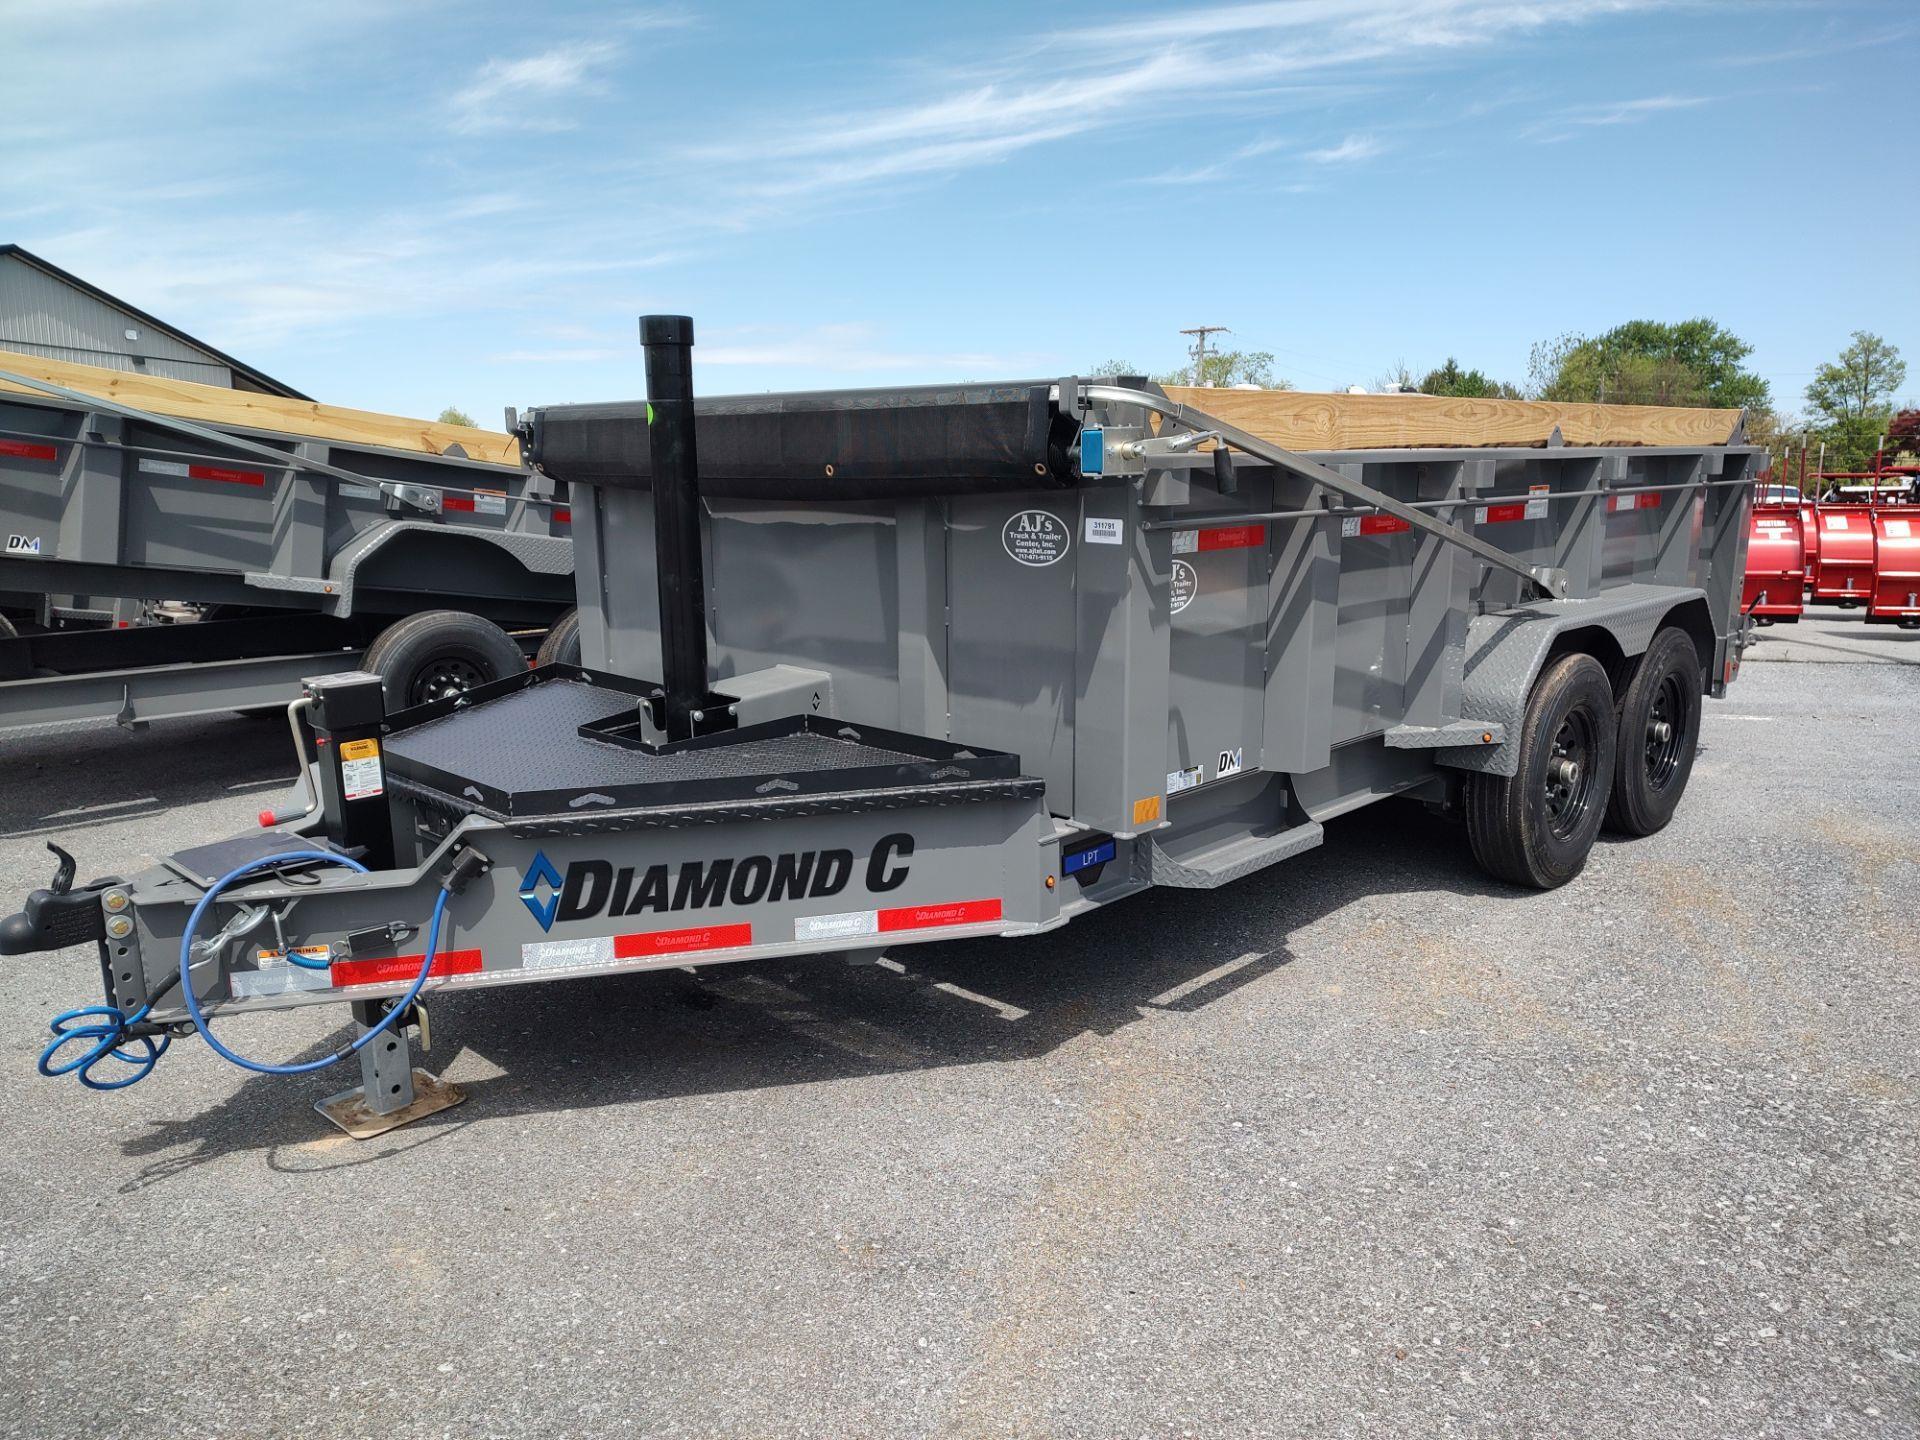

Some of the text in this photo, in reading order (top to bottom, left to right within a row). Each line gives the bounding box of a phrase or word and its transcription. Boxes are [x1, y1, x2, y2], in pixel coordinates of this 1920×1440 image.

[1018, 514, 1053, 533] AJ's
[1093, 521, 1115, 530] 311791
[8, 535, 39, 550] DM
[1009, 531, 1062, 541] Truck & Trailer
[1016, 540, 1056, 549] Center, Inc.
[1171, 563, 1186, 581] J's
[1218, 749, 1241, 773] DM
[1082, 849, 1099, 866] LPT
[555, 833, 915, 923] DIAMOND C
[919, 907, 966, 922] DIAMOND C
[814, 919, 854, 931] DIAMOND
[853, 917, 862, 927] C
[660, 932, 711, 946] DIAMOND C
[382, 961, 423, 974] DIAMON
